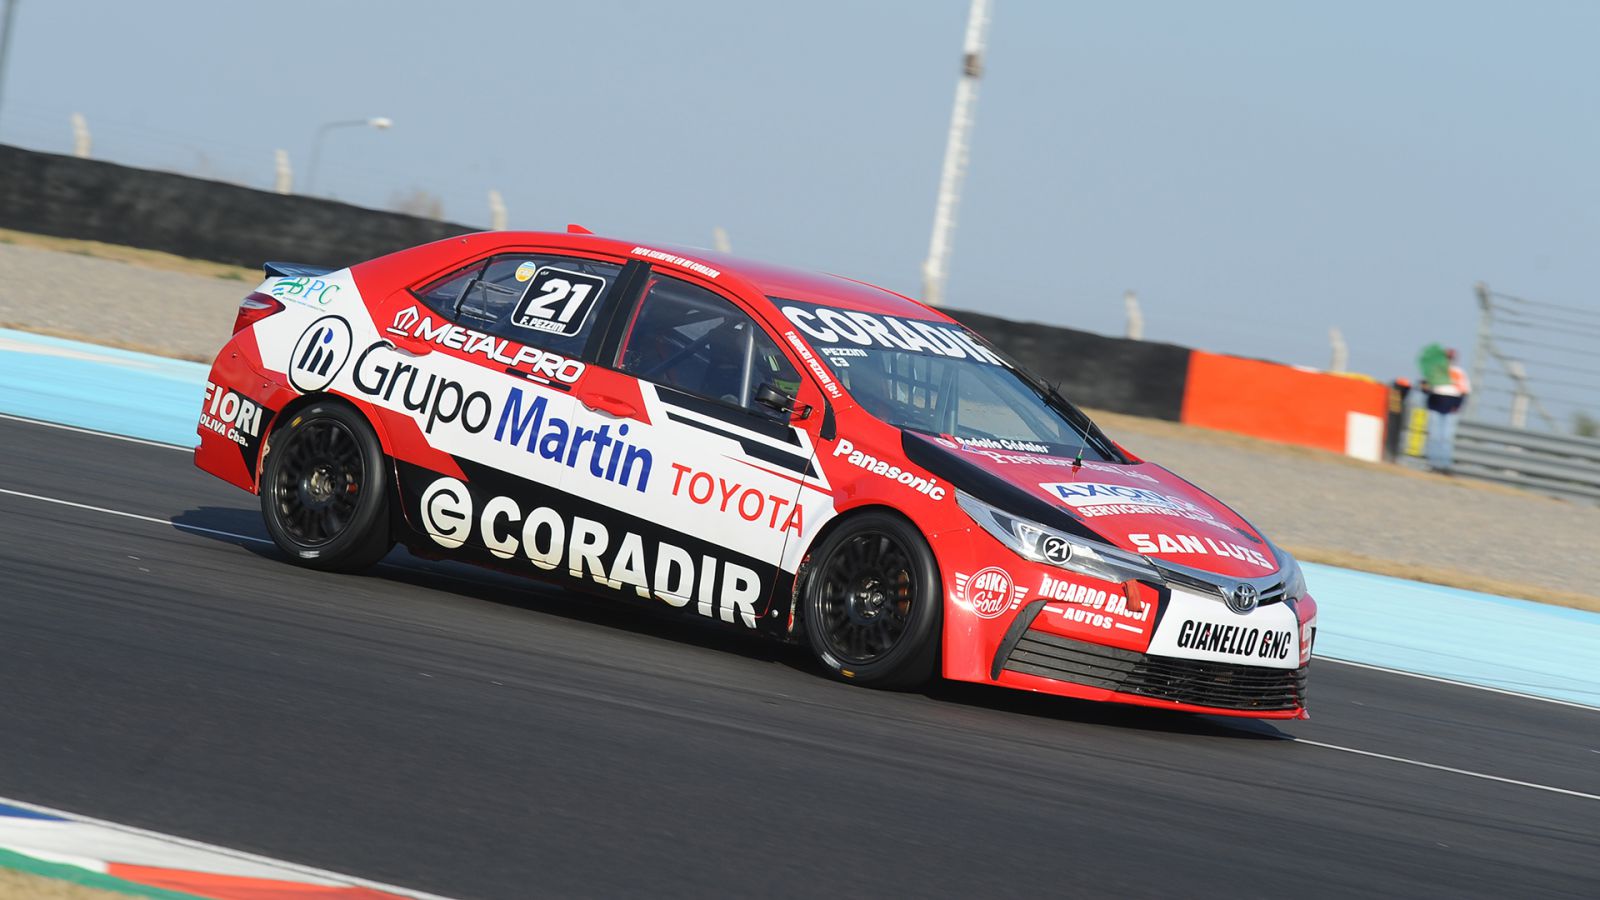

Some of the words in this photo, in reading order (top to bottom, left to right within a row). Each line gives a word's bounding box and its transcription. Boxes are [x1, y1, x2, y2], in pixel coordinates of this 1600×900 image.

[287, 277, 341, 305] BPC
[524, 278, 593, 323] 21
[528, 317, 567, 333] PEZZINI
[413, 314, 587, 384] METALPRO
[821, 347, 868, 357] PEZZINI
[200, 413, 226, 436] OLIVA
[352, 340, 493, 435] Grupo
[493, 386, 654, 493] Martin
[832, 438, 946, 501] Panasonic
[671, 462, 804, 538] TOYOTA
[480, 495, 763, 629] CORADIR
[1048, 540, 1069, 559] 21
[1128, 533, 1208, 554] SAN
[1206, 537, 1275, 571] LUIS
[973, 590, 1005, 613] Goal
[974, 572, 1009, 593] BIKE
[1038, 575, 1107, 609] RICARDO
[1104, 593, 1151, 622] BAI
[1063, 607, 1114, 629] AUTOS
[1177, 619, 1259, 656] GIANELLO
[1258, 629, 1292, 660] GNC
